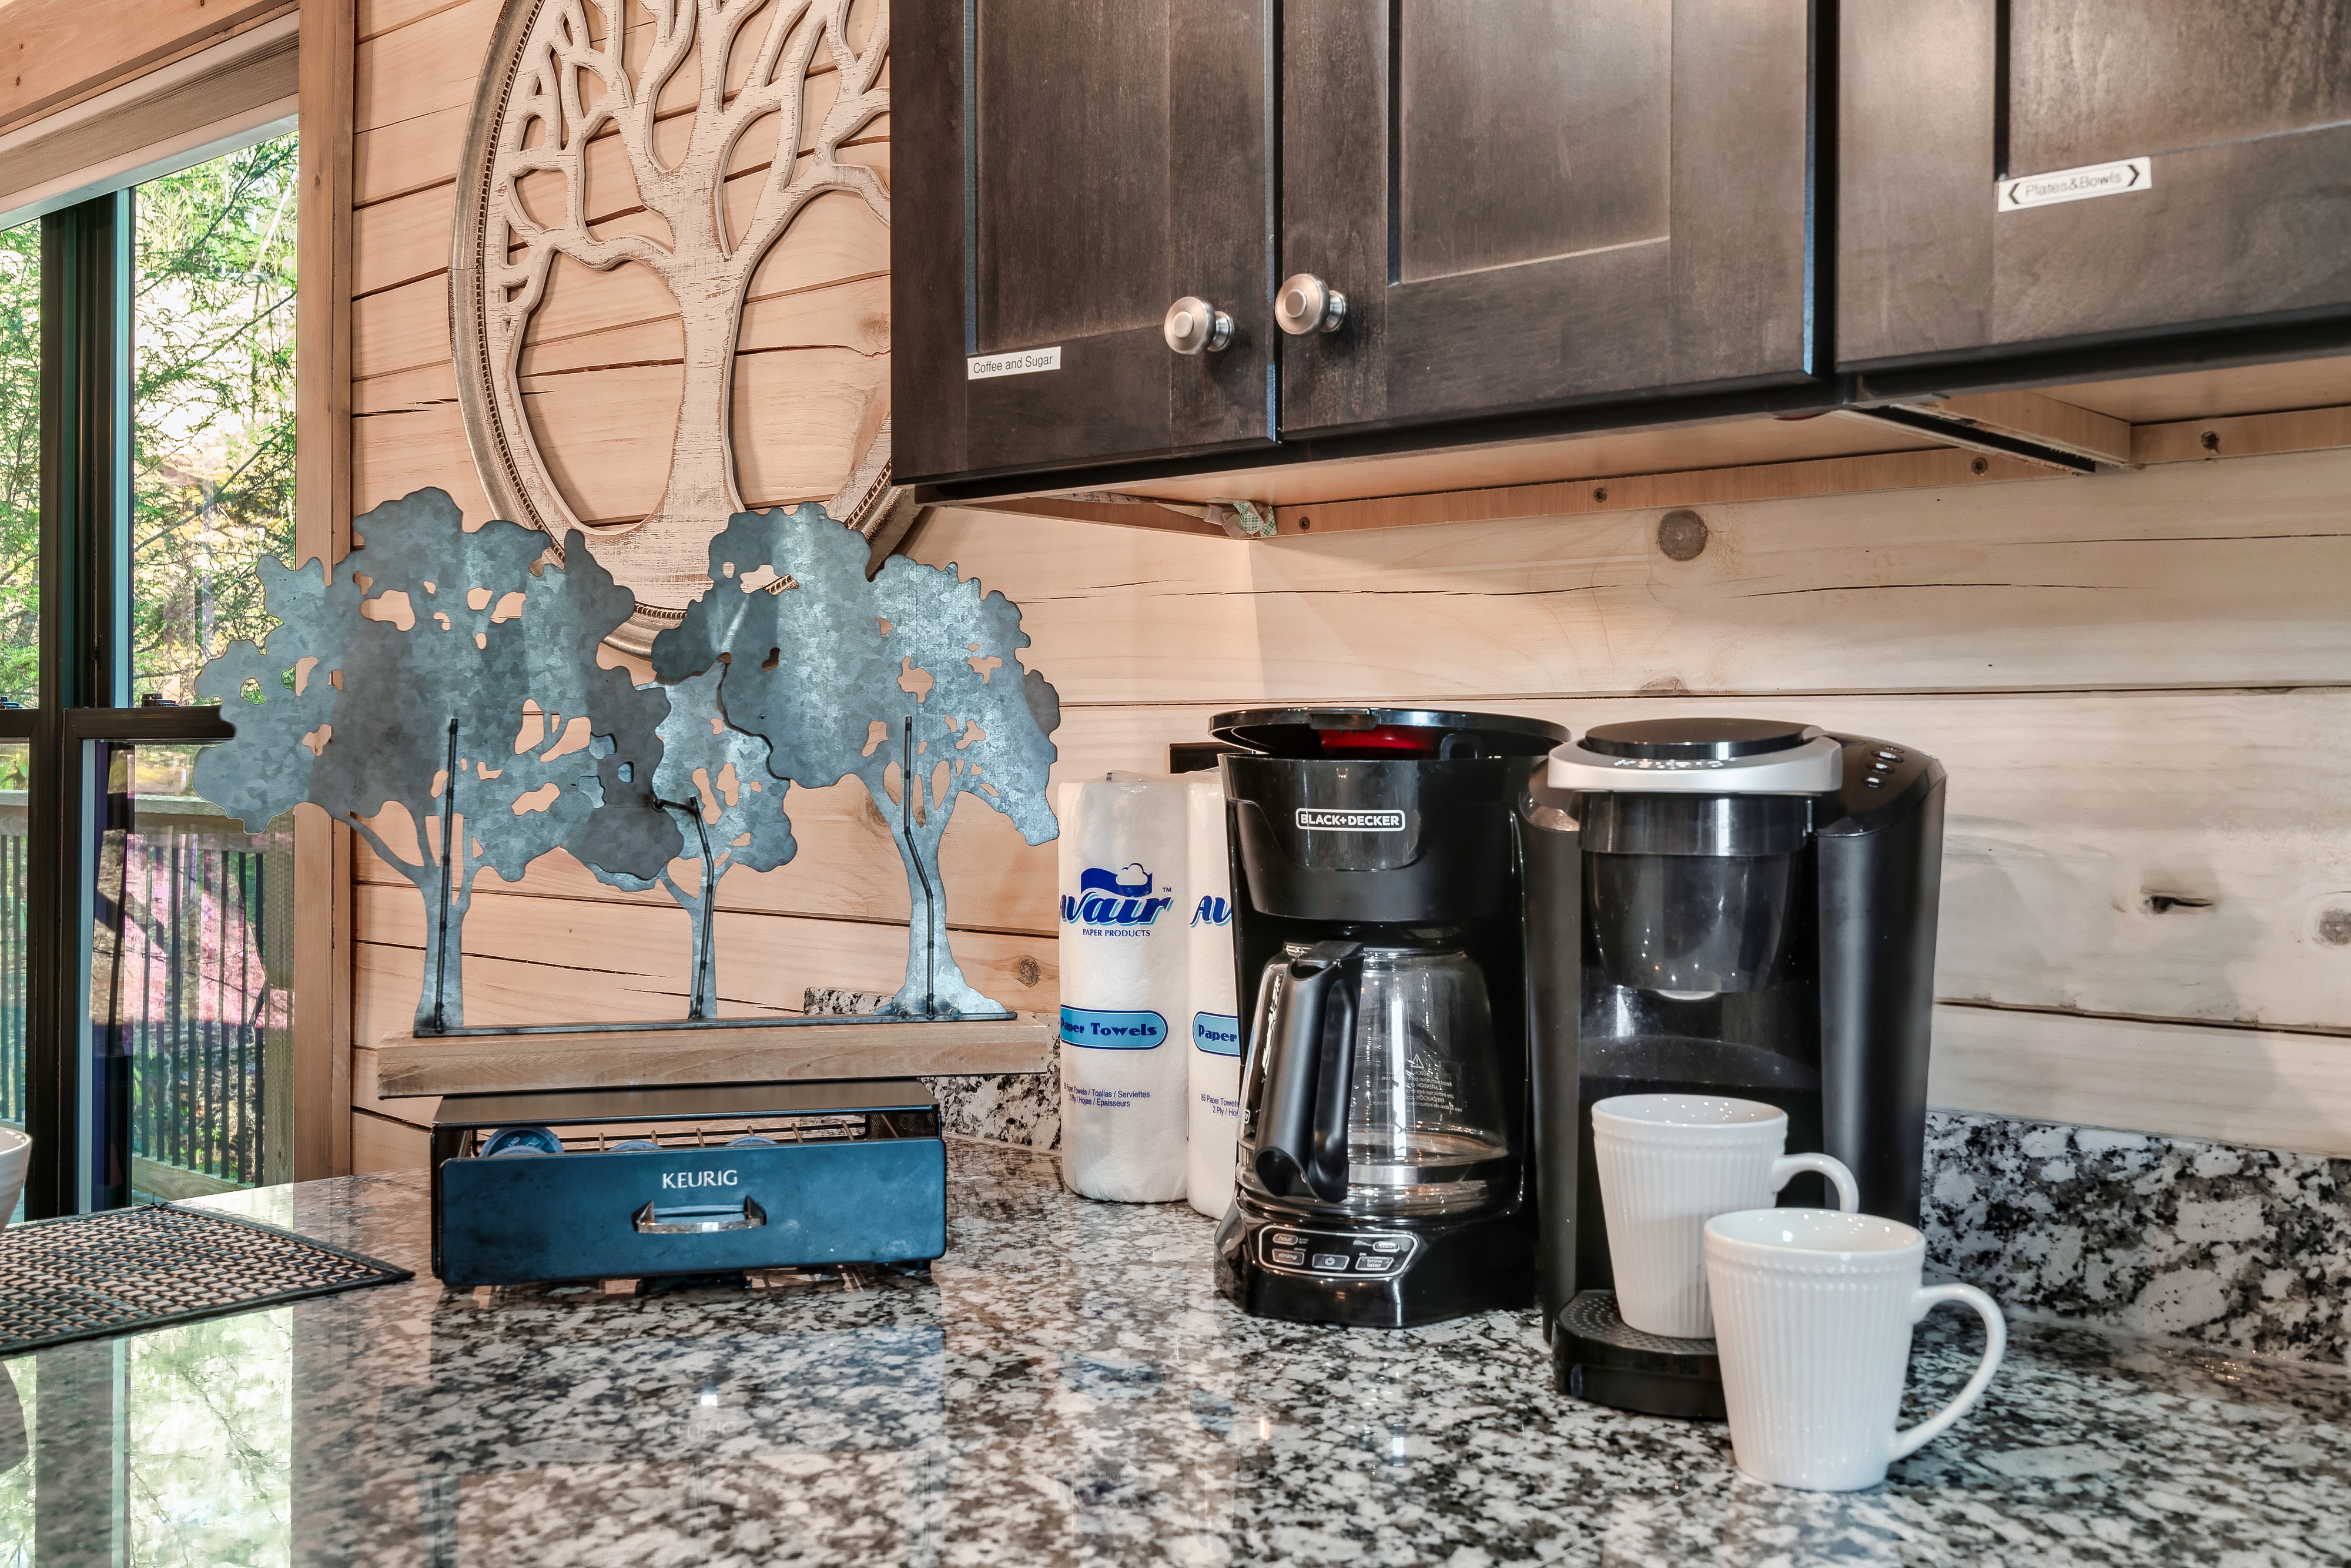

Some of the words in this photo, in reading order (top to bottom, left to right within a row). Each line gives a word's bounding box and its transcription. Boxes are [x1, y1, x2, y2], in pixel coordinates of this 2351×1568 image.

[2025, 172, 2121, 197] Plates&Bowls
[973, 361, 1002, 374] Coffee
[1005, 357, 1022, 370] and
[1025, 356, 1053, 368] Sugar
[1301, 814, 1399, 826] BLACK+DECKER
[1104, 929, 1150, 937] PRODUCTS
[1090, 1022, 1157, 1036] Towels
[1198, 1024, 1237, 1043] Paper
[1073, 1086, 1087, 1095] Towels
[1091, 1088, 1112, 1098] Toallas
[1117, 1090, 1150, 1098] Serviettes
[1079, 1097, 1092, 1106] Hojas
[1097, 1098, 1131, 1108] Epaisseurs
[1201, 1094, 1206, 1102] 85
[1207, 1095, 1220, 1105] Paper
[662, 1170, 738, 1189] KEURIG
